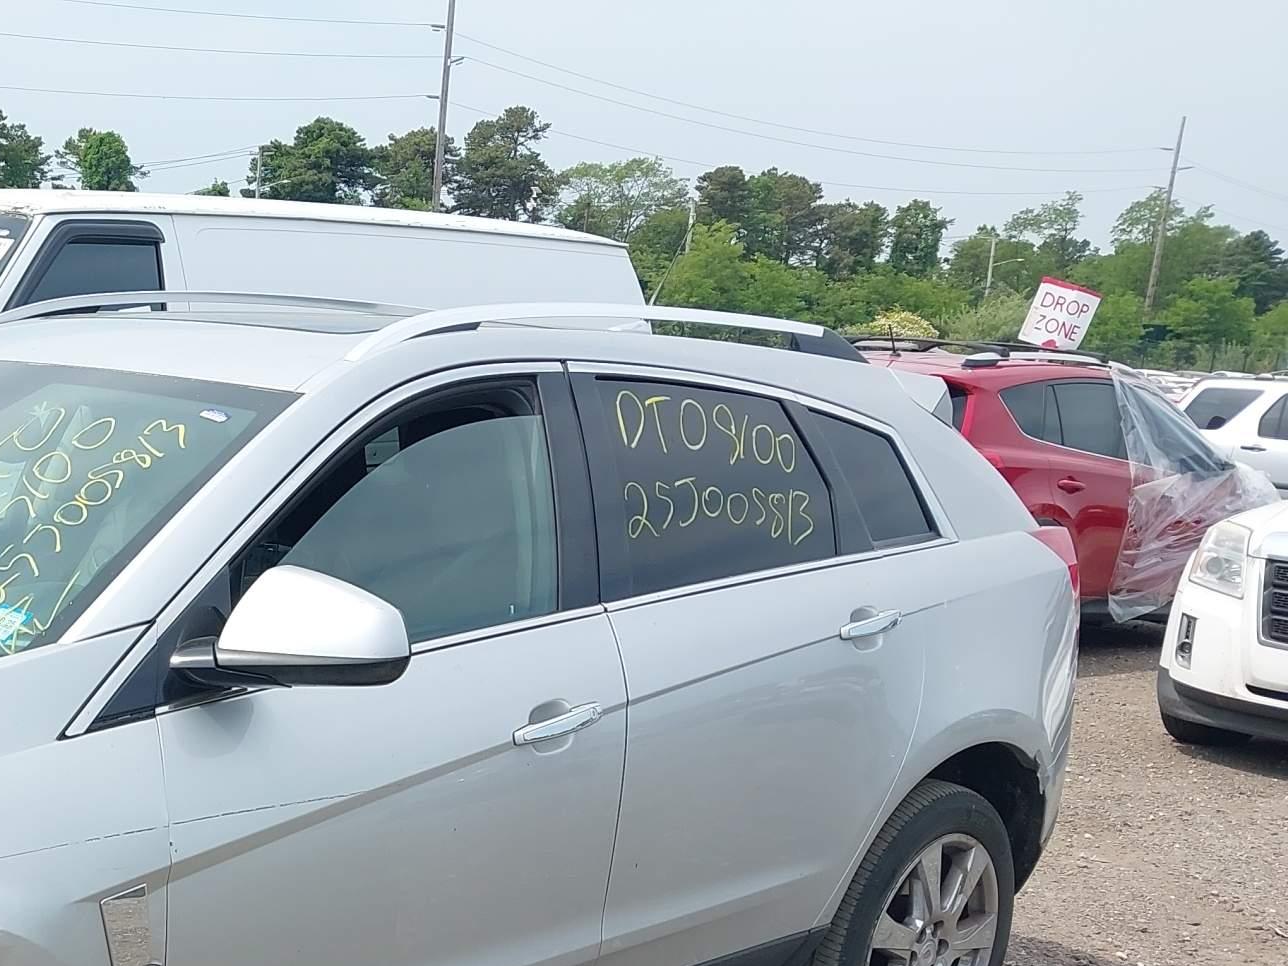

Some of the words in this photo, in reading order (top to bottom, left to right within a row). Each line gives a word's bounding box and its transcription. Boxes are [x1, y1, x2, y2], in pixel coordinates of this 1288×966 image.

[1040, 291, 1090, 319] DROP
[1034, 314, 1081, 342] ZONE
[623, 476, 815, 546] 25J005813
